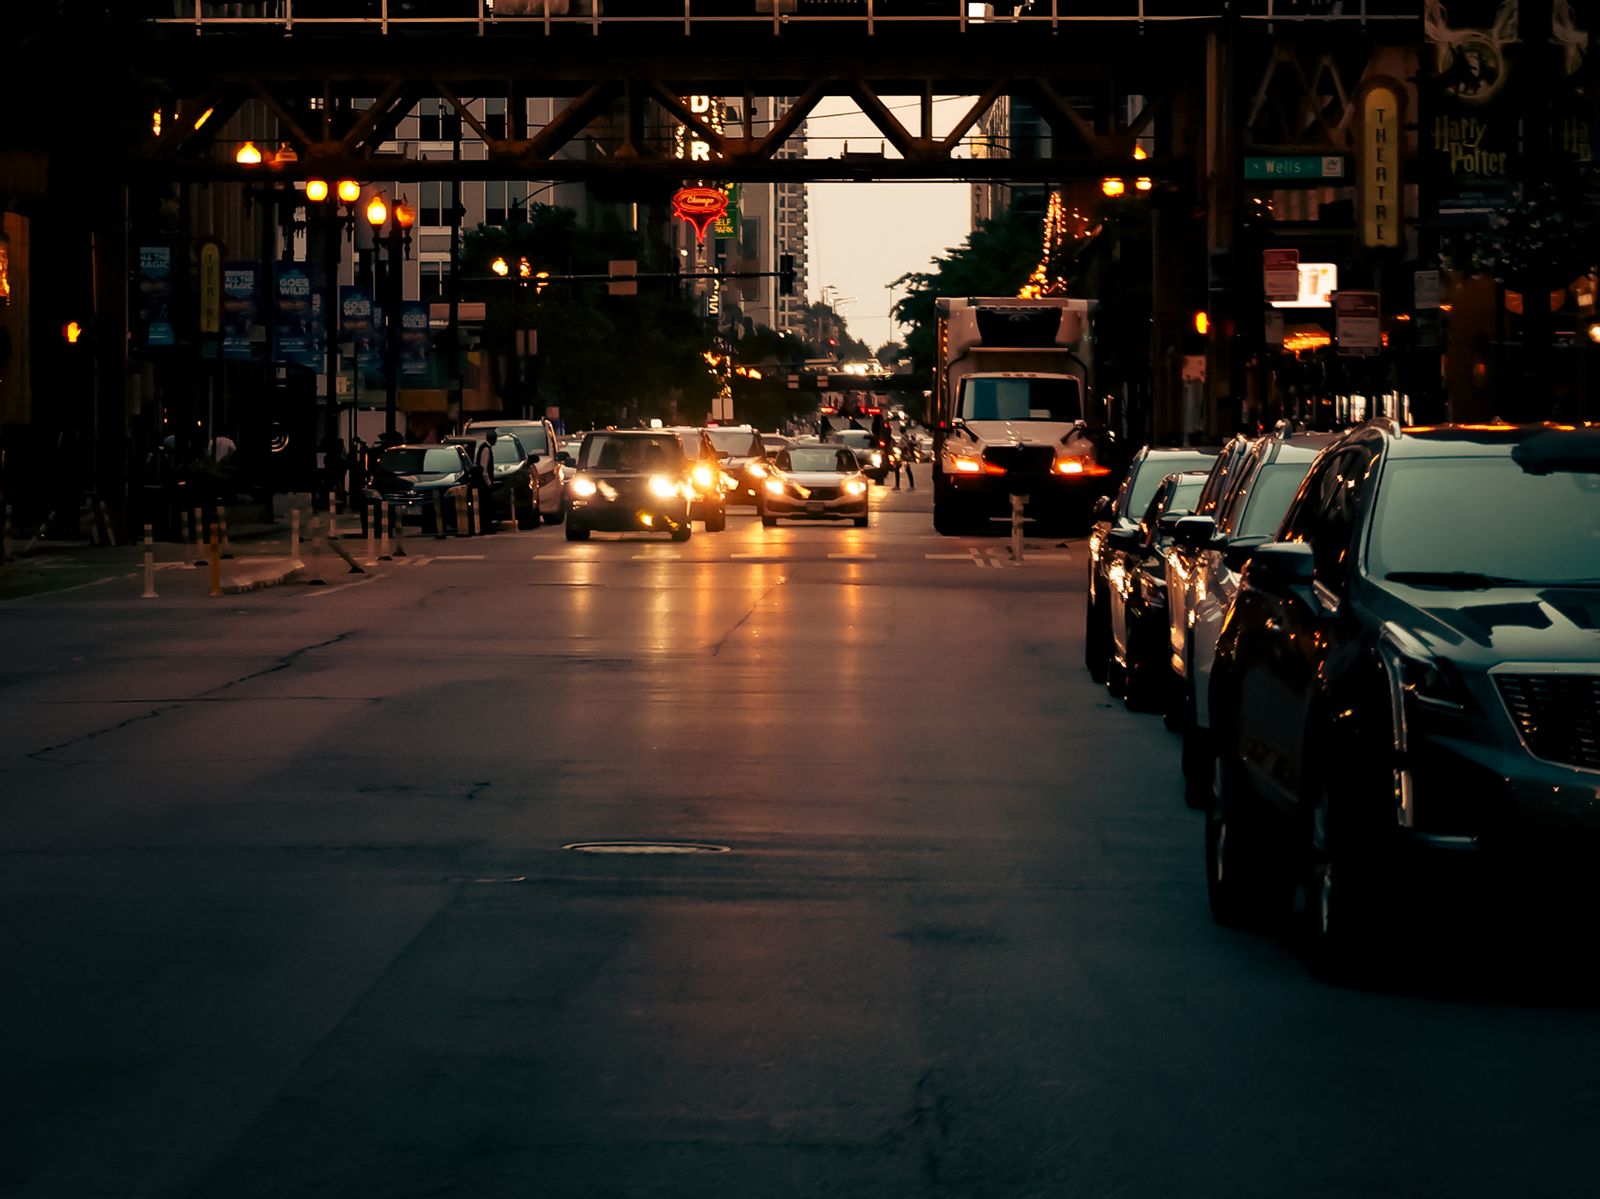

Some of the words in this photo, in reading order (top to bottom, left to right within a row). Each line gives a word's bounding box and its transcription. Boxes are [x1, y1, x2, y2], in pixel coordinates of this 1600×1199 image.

[1430, 114, 1488, 152] Harry
[1265, 160, 1302, 174] Wells
[1450, 142, 1508, 176] Potter
[1375, 108, 1387, 240] THEATRE
[280, 278, 309, 286] GOES
[344, 300, 370, 308] GOES
